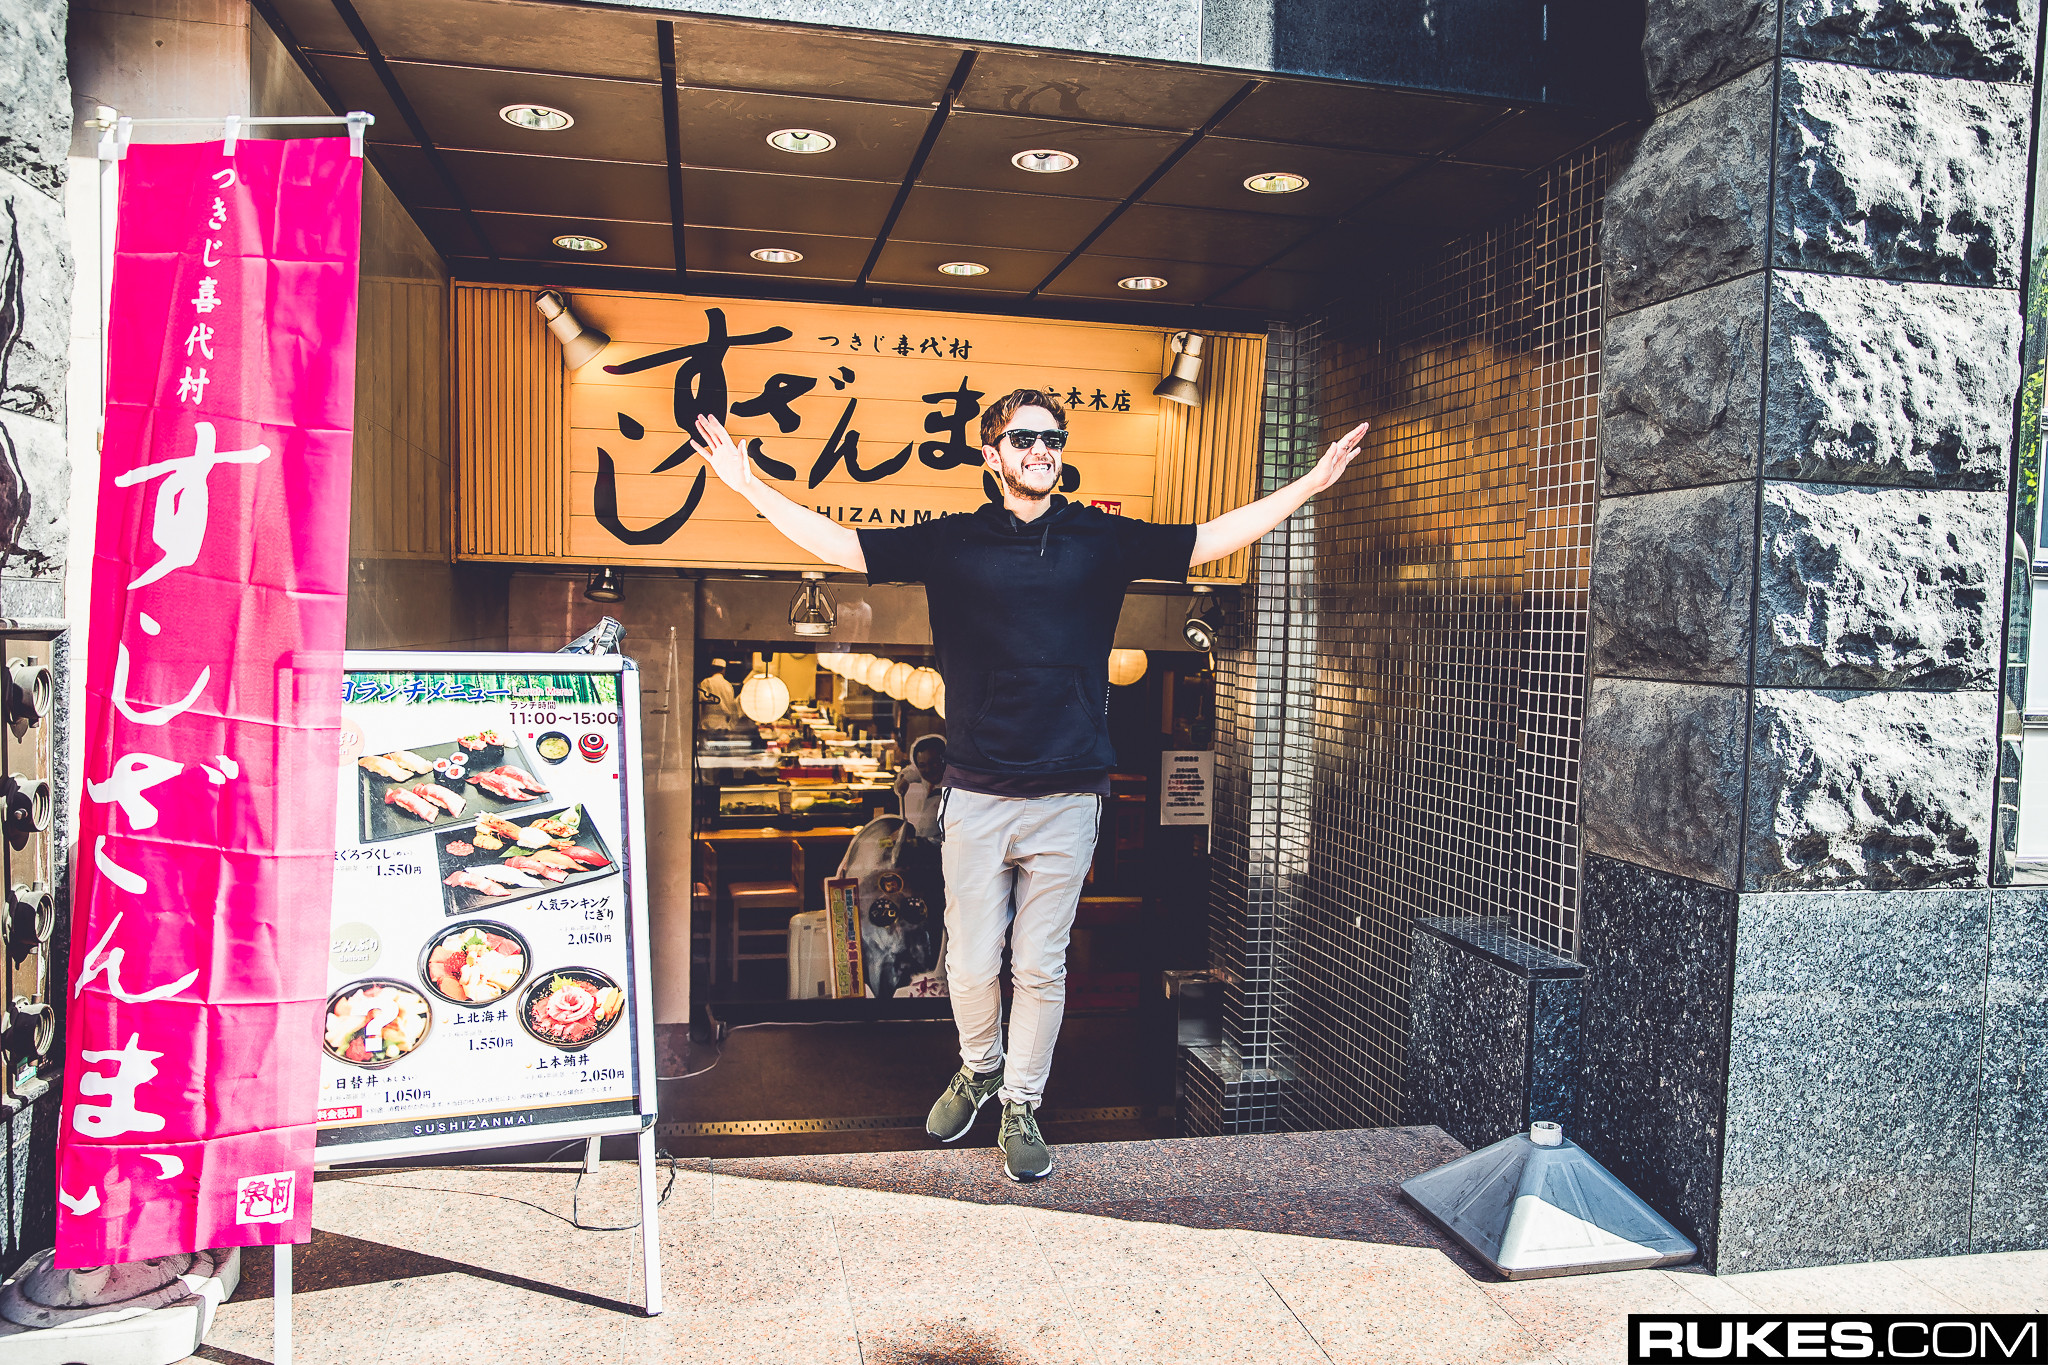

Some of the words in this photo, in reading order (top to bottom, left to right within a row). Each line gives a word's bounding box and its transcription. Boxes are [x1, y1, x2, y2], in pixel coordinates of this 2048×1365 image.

[178, 167, 235, 406] つきじ喜代村
[818, 332, 973, 360] つきじ喜代村
[546, 687, 573, 696] Menu
[510, 701, 556, 710] ランチ時間
[60, 421, 272, 1217] すしざんまい
[536, 896, 610, 911] 人気ランキング
[584, 908, 614, 921] にぎり
[336, 1074, 379, 1089] 日替丼
[414, 1114, 533, 1135] SUSHIZANMAI
